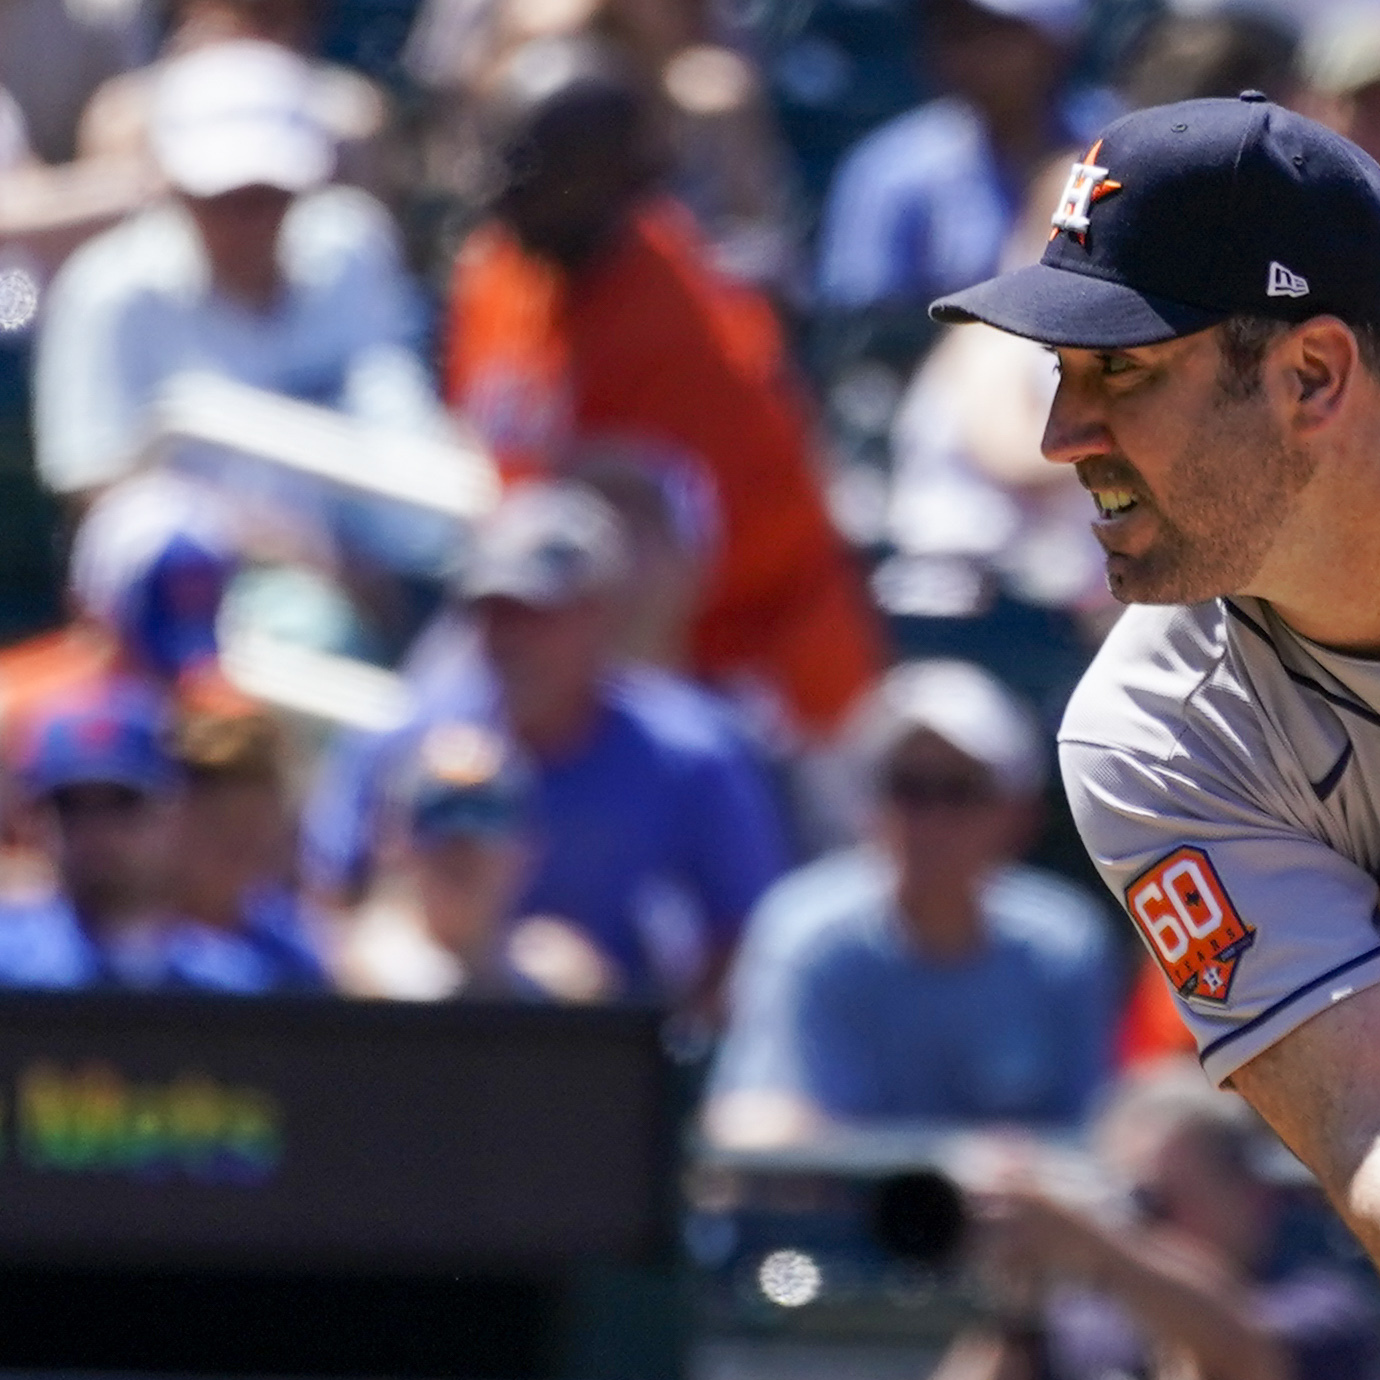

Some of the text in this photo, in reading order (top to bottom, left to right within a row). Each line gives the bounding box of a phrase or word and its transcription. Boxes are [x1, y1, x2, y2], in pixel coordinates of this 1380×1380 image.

[1052, 161, 1110, 234] H
[1134, 859, 1223, 964] 60
[1174, 927, 1237, 980] YEARS
